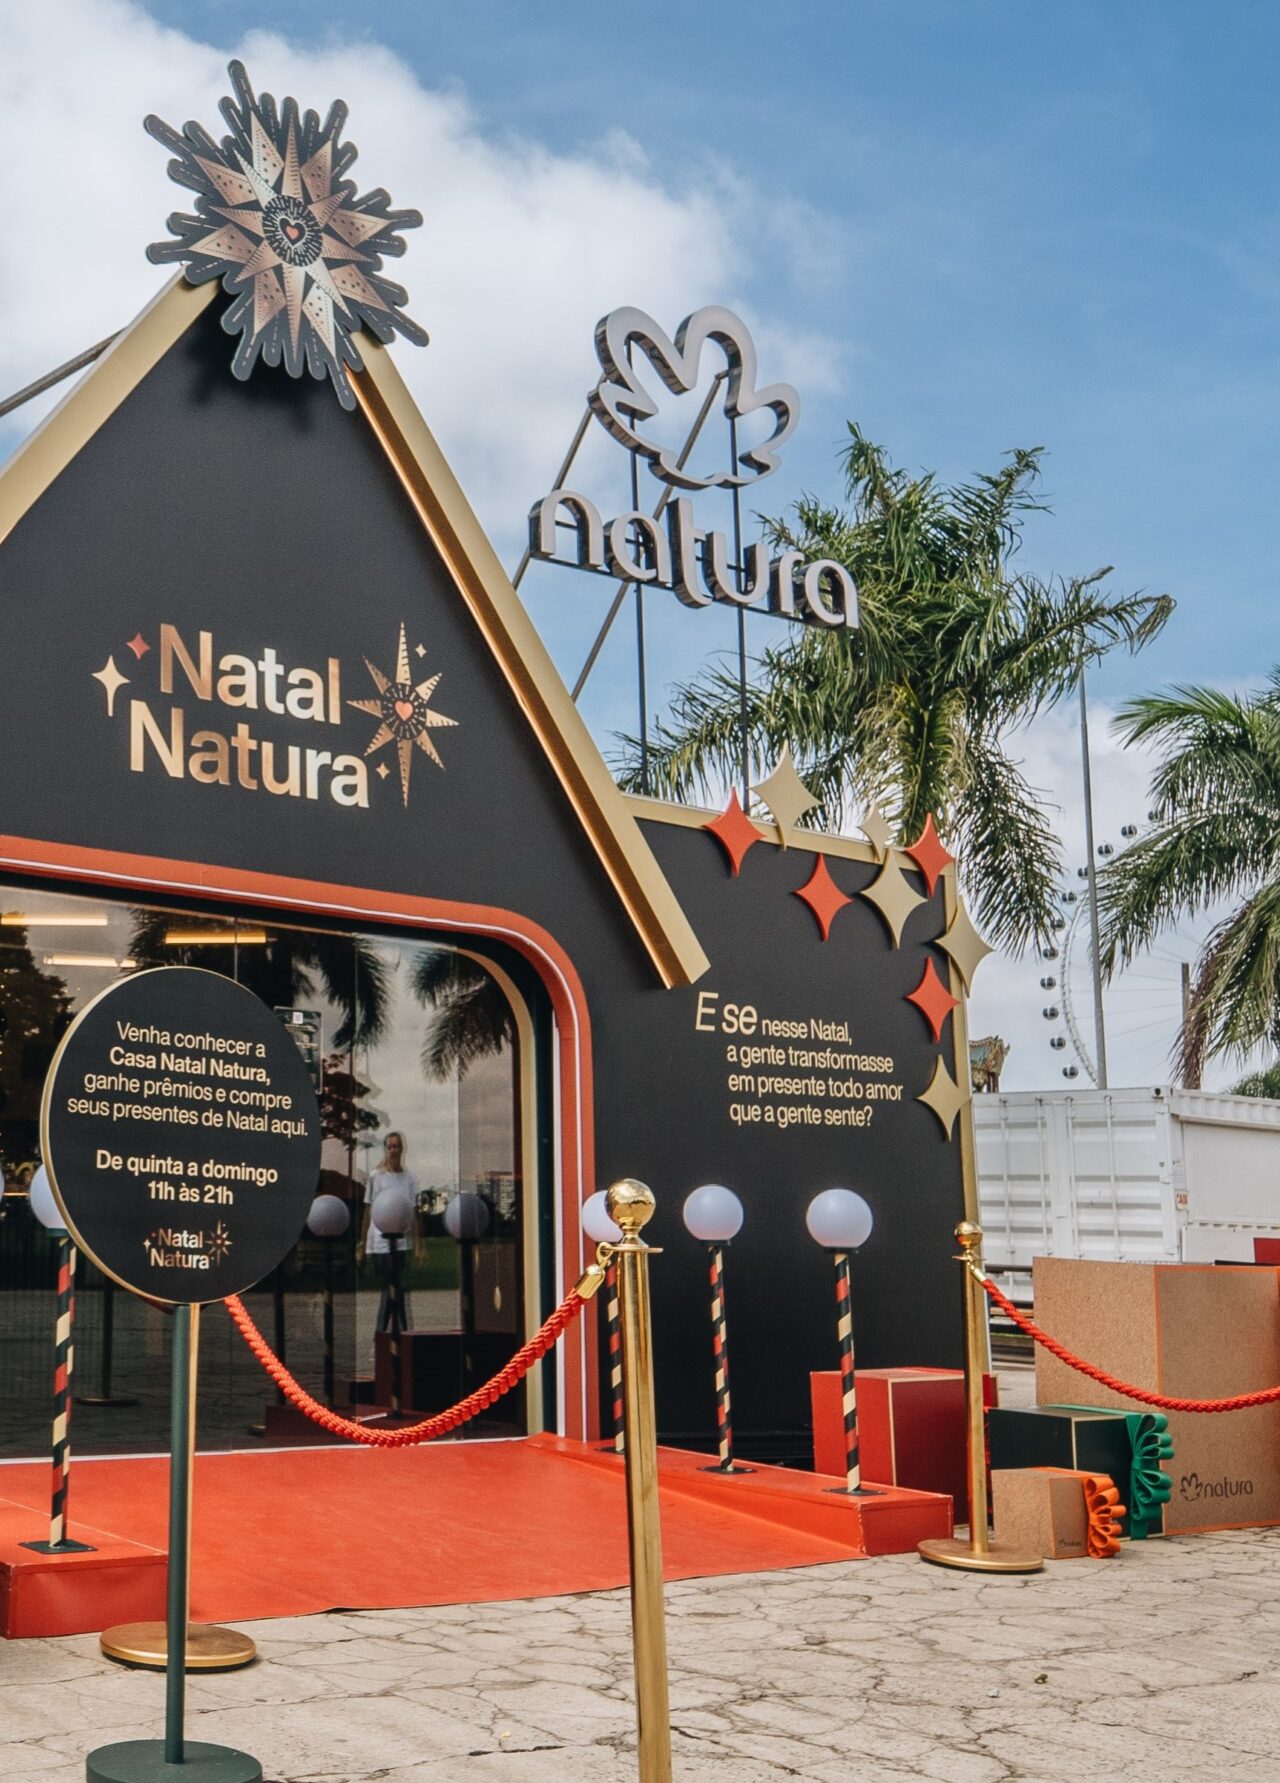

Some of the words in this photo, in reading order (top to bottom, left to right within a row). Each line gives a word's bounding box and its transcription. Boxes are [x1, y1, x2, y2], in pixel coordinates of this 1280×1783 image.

[529, 490, 859, 629] natura
[161, 623, 341, 725] Natal
[130, 699, 369, 808] Natura
[695, 992, 718, 1032] E
[722, 1003, 757, 1035] se
[762, 1019, 807, 1038] nesse
[811, 1019, 852, 1045] Natal,
[117, 1021, 170, 1046] Venha
[174, 1031, 251, 1056] conhecer
[256, 1043, 266, 1058] a
[110, 1047, 156, 1070] Casa
[161, 1052, 205, 1075] Natal
[210, 1059, 271, 1085] Natura,
[727, 1045, 737, 1062] a
[741, 1045, 785, 1068] gente
[789, 1047, 893, 1073] transformasse
[84, 1072, 140, 1094] ganhe
[144, 1078, 212, 1101] prêmios
[216, 1088, 226, 1102] e
[229, 1089, 291, 1111] compre
[728, 1074, 754, 1092] em
[758, 1076, 825, 1097] presente
[828, 1078, 863, 1098] todo
[866, 1083, 903, 1100] amor
[68, 1098, 109, 1115] seus
[113, 1101, 198, 1125] presentes
[202, 1106, 223, 1127] de
[227, 1110, 267, 1132] Natal
[271, 1118, 308, 1139] aqui.
[730, 1103, 761, 1125] que
[765, 1106, 774, 1122] a
[778, 1104, 821, 1128] gente
[825, 1105, 872, 1126] sente?
[97, 1150, 123, 1170] De
[127, 1155, 183, 1176] quinta
[188, 1161, 198, 1176] a
[202, 1160, 278, 1186] domingo
[148, 1181, 174, 1200] 11h
[179, 1182, 199, 1202] às
[203, 1185, 233, 1204] 21h
[158, 1229, 203, 1248] Natal
[150, 1248, 209, 1269] Natura
[1204, 1476, 1253, 1498] natura
